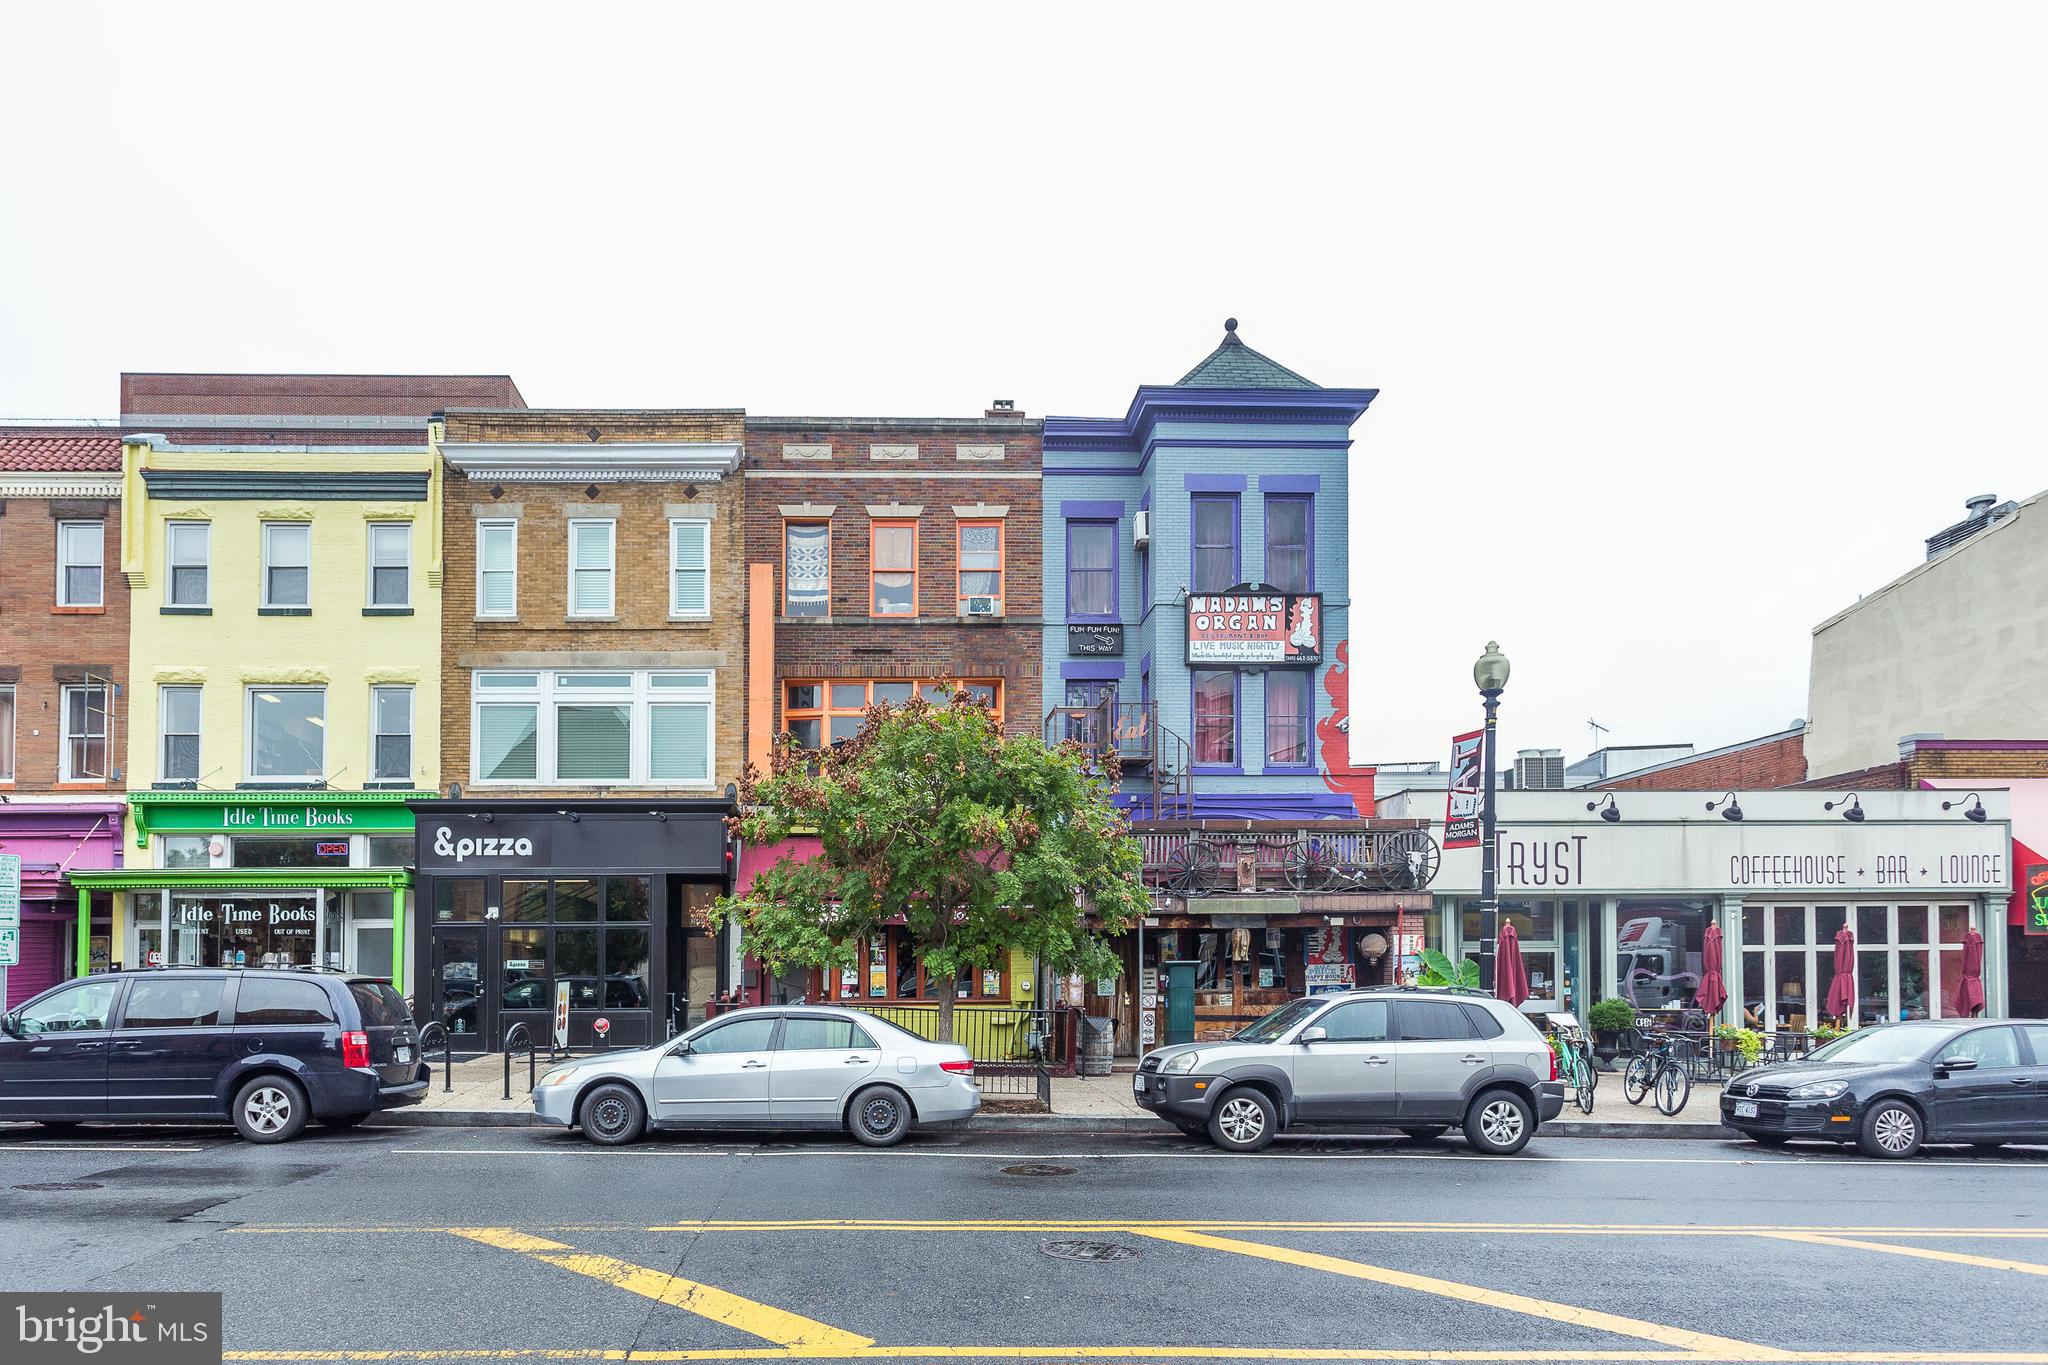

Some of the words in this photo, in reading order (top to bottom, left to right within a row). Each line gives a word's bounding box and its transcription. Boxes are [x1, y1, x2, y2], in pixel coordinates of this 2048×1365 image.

[1190, 596, 1283, 614] MADAM'S
[1195, 615, 1278, 631] ORGAN
[1079, 644, 1096, 652] THIS
[1193, 642, 1216, 651] LIVE
[1219, 642, 1245, 651] MUSIC
[1246, 642, 1281, 651] NIGHTLY
[222, 807, 256, 827] Idle
[259, 807, 300, 827] Time
[304, 807, 353, 827] Books
[1449, 821, 1475, 832] ADAMS
[1445, 829, 1478, 839] MORGAN
[319, 844, 347, 854] OPEN
[434, 826, 533, 862] &pizza
[1730, 855, 1846, 885] COFFEEHOUSE
[1875, 855, 1910, 885] BAR
[1940, 854, 2002, 884] LOUNGE
[180, 904, 213, 924] Idle
[222, 904, 262, 924] Time
[269, 904, 316, 924] Books
[1635, 1017, 1652, 1028] OPEN
